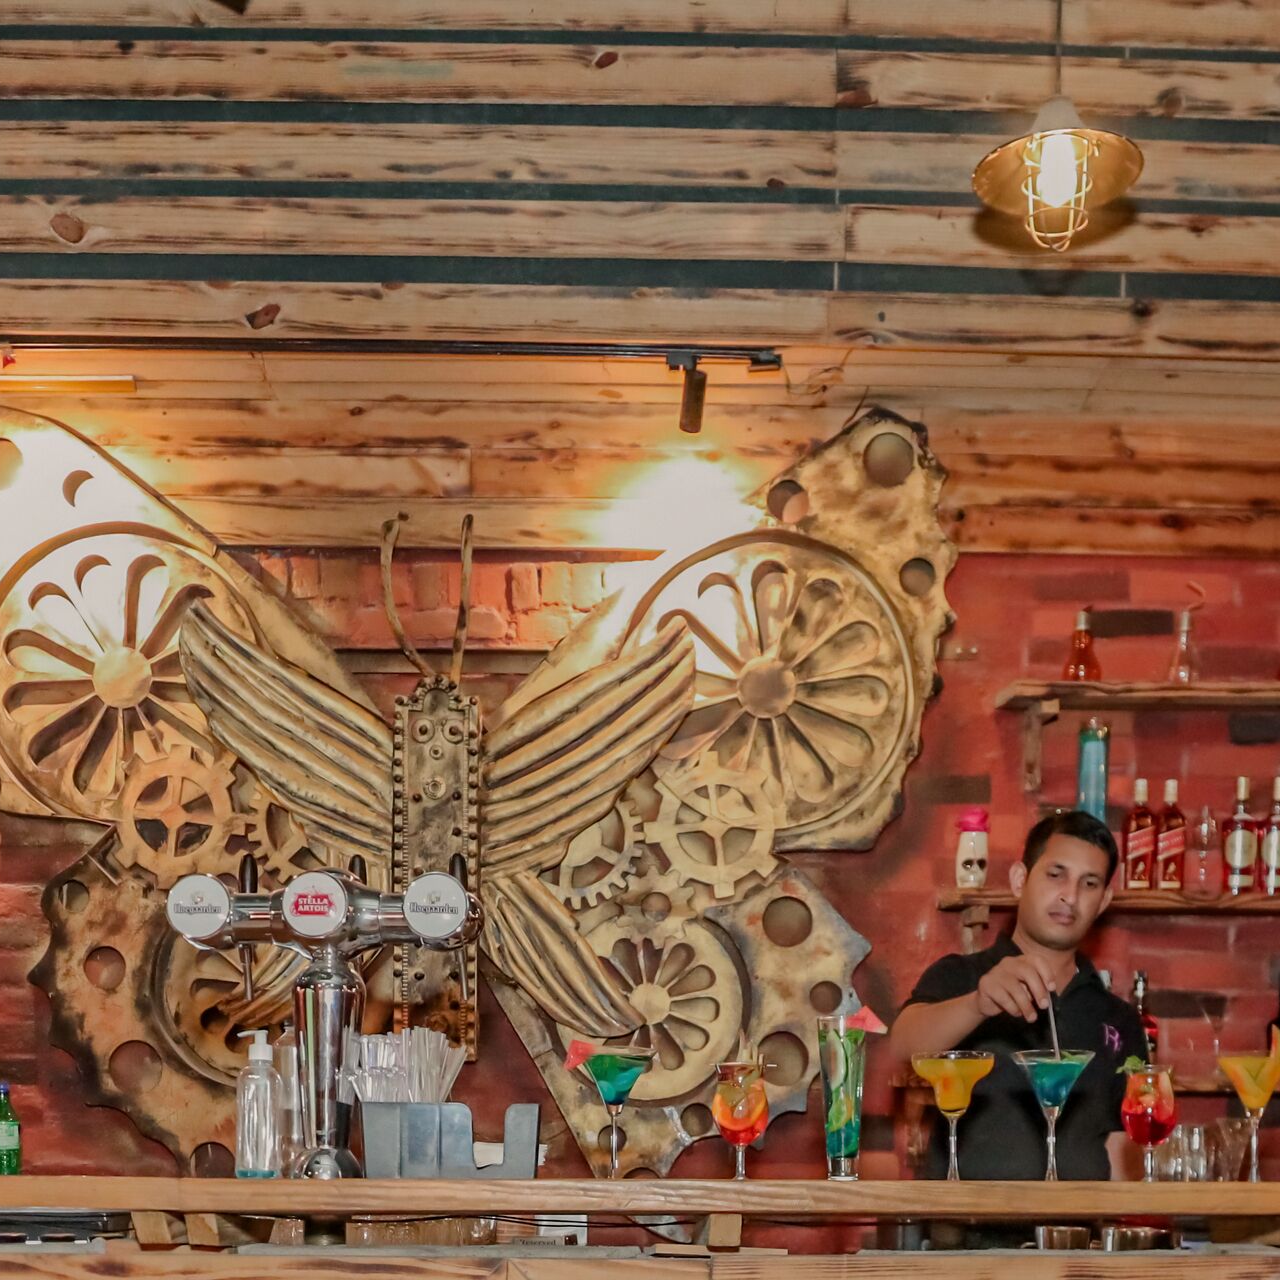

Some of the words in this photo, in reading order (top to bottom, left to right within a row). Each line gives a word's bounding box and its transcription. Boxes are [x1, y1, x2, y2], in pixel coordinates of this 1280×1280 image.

[297, 897, 329, 905] STELLA
[173, 903, 221, 915] Hoegaarden
[297, 904, 329, 912] ARTOIS
[409, 902, 459, 915] Hoegaarden
